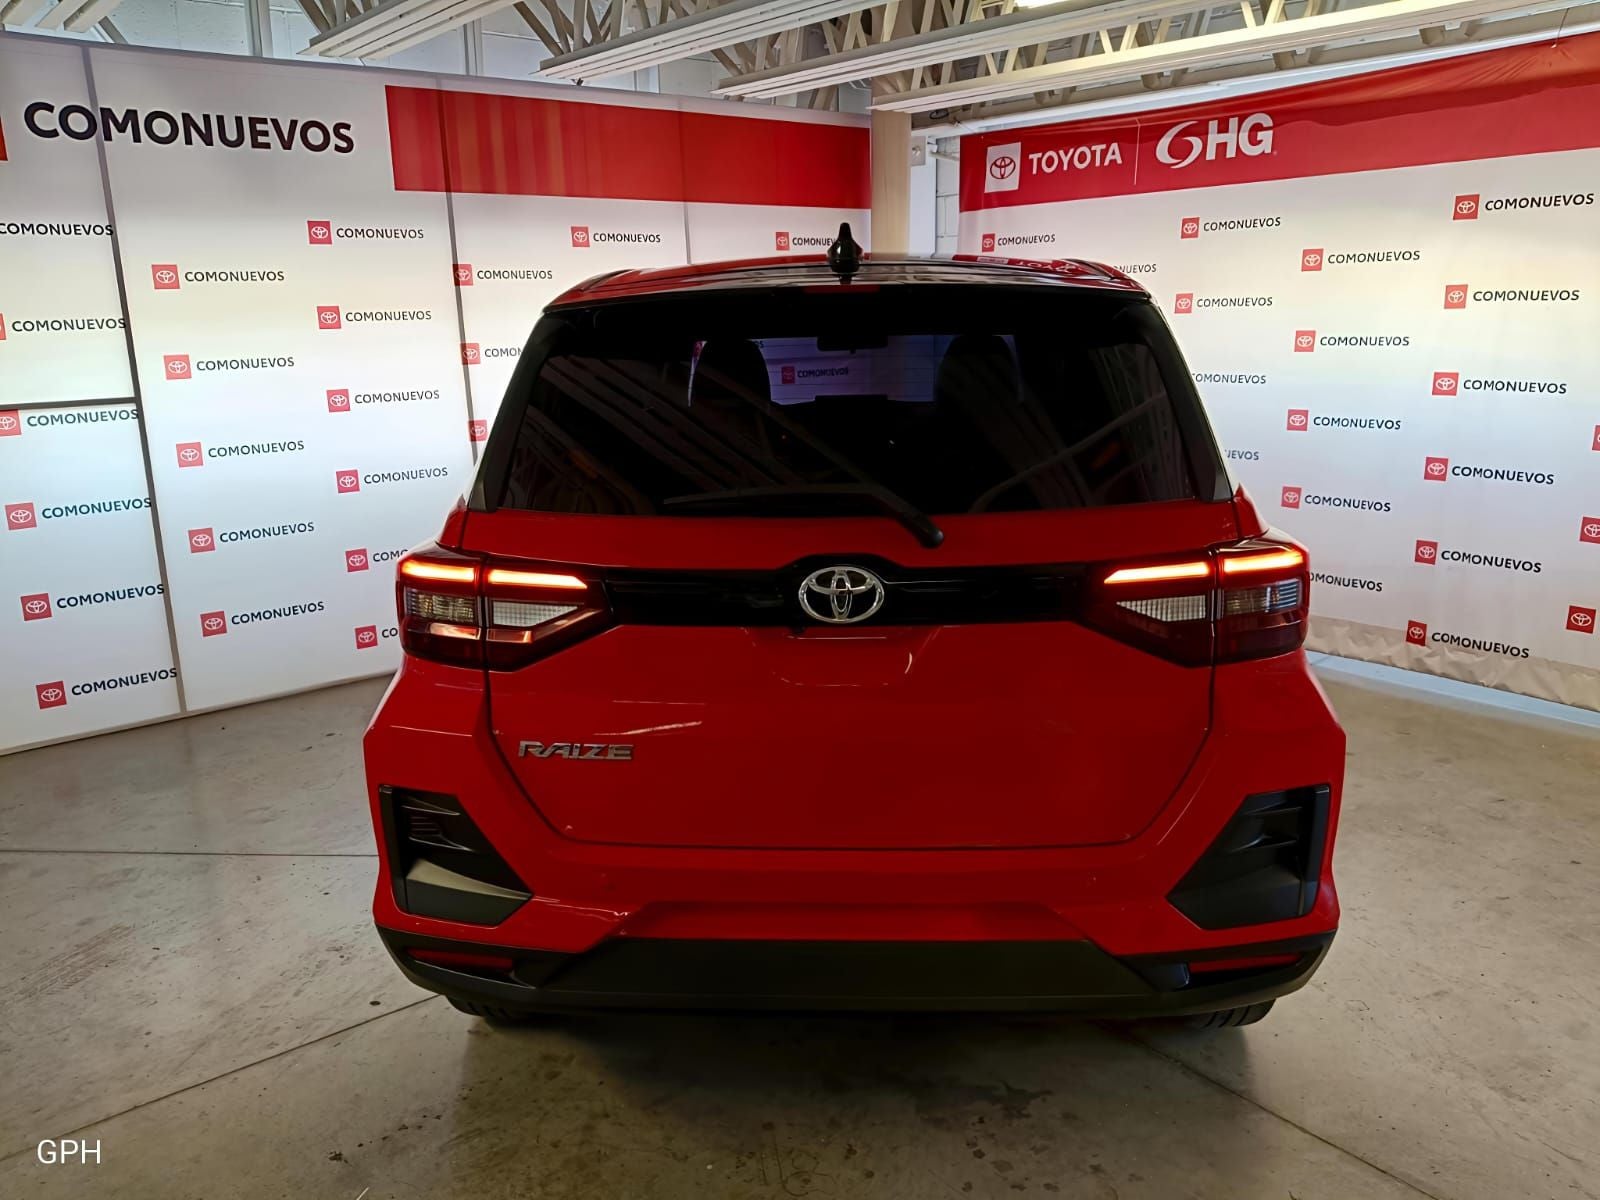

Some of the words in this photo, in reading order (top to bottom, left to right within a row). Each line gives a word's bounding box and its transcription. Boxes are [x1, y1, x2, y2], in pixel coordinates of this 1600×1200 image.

[23, 100, 354, 154] COMONUEVOS
[1028, 141, 1123, 175] TOYOTA
[1484, 192, 1594, 210] COMONUEVOS
[1203, 216, 1280, 231] COMONUEVOS
[336, 227, 423, 238] COMONUEVOS
[592, 232, 660, 242] COMONUEVOS
[997, 233, 1055, 246] COMONUEVOS
[1327, 250, 1420, 264] COMONUEVOS
[184, 270, 284, 281] COMONUEVOS
[476, 269, 552, 279] COMONUEVOS
[1196, 296, 1272, 307] COMONUEVOS
[1472, 289, 1579, 301] COMONUEVOS
[345, 310, 431, 321] COMONUEVOS
[11, 317, 127, 332] COMONUEVOS
[1319, 336, 1409, 346] COMONUEVOS
[196, 356, 294, 370] COMONUEVOS
[1190, 372, 1266, 384] OMONUEVOS
[1463, 379, 1566, 394] COMONUEVOS
[354, 389, 439, 403] COMONUEVOS
[26, 408, 139, 426] COMONUEVOS
[1313, 416, 1400, 430] COMONUEVOS
[208, 440, 304, 457] COMONUEVOS
[363, 466, 447, 484] COMONUEVOS
[1451, 465, 1554, 484] COMONUEVOS
[41, 497, 152, 519] COMONUEVOS
[1304, 494, 1390, 512] COMONUEVOS
[219, 521, 314, 542] COMONUEVOS
[1440, 550, 1541, 573] COMONUEVOS
[56, 583, 165, 609] COMONUEVOS
[231, 601, 324, 624] COMONUEVOS
[1431, 632, 1529, 658] COMONUEVOS
[71, 666, 178, 696] COMONUEVOS
[517, 739, 634, 760] RAIZE
